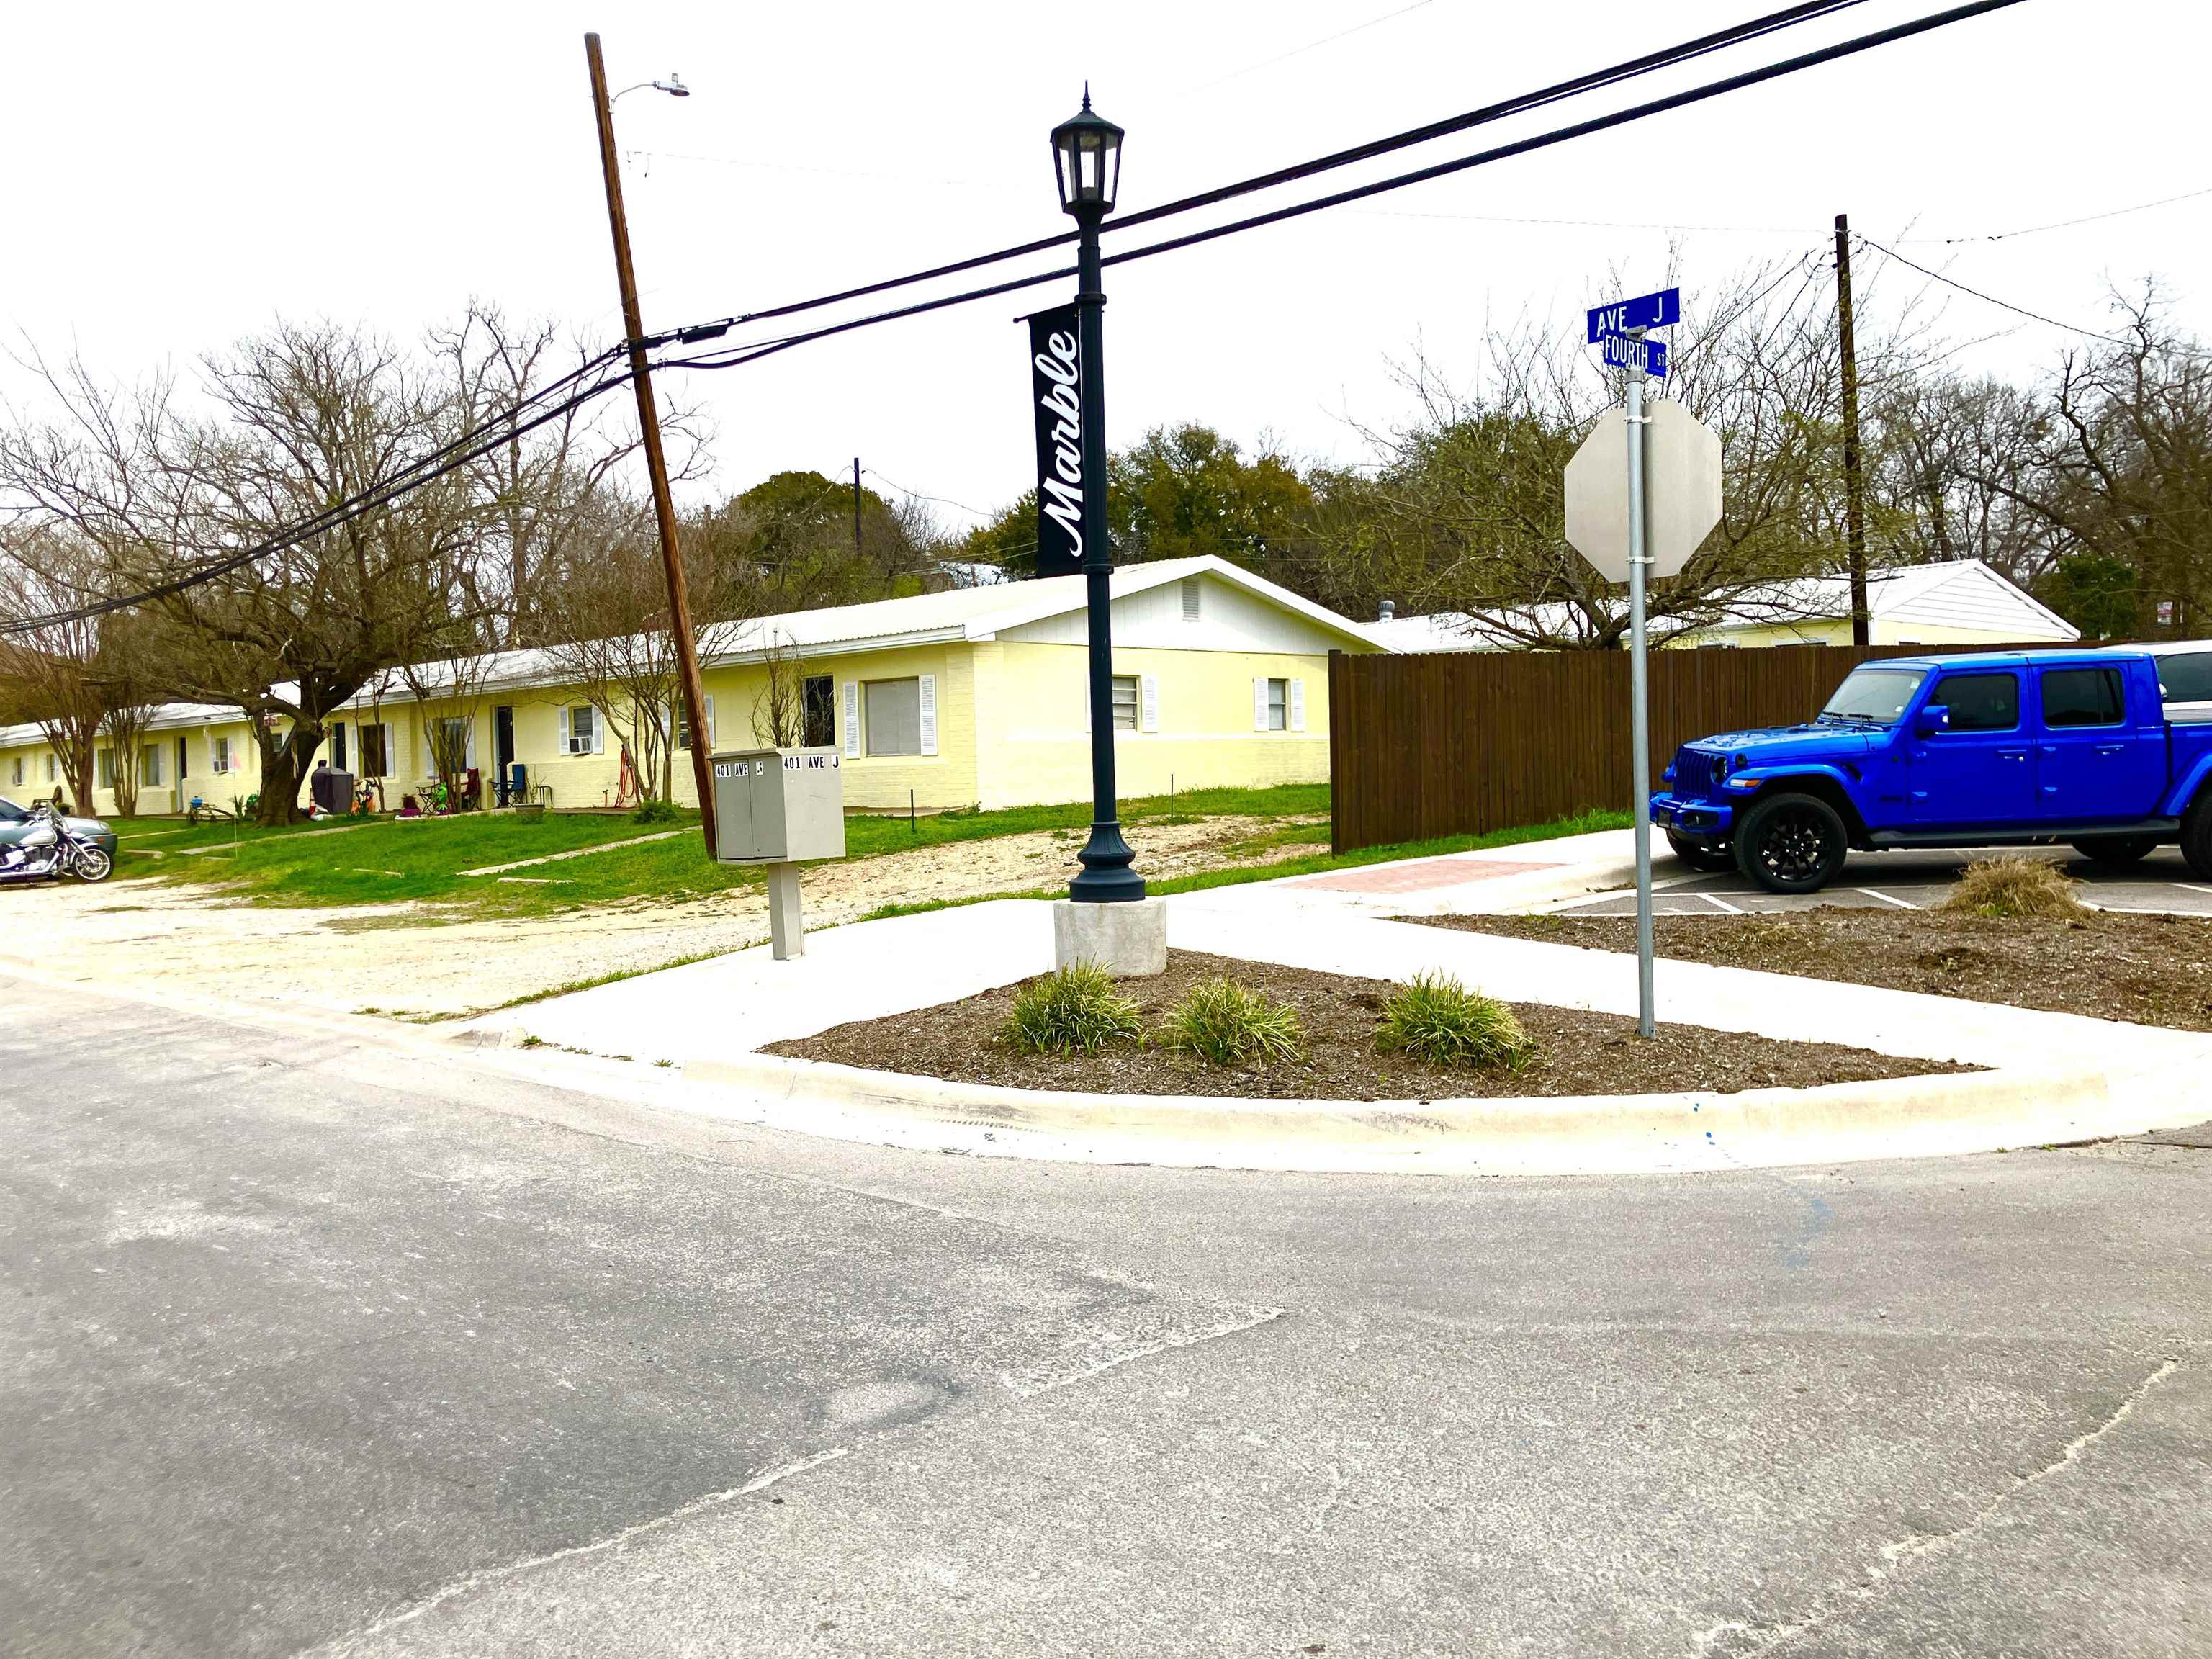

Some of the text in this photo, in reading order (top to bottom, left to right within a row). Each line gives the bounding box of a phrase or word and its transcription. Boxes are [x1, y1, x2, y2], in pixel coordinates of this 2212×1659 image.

[1596, 297, 1663, 338] AVE J
[1605, 334, 1665, 369] FOURTH ST
[1035, 330, 1084, 557] Marble
[717, 765, 730, 777] 401
[735, 763, 748, 775] AVE
[784, 755, 839, 769] 401 AVE J
